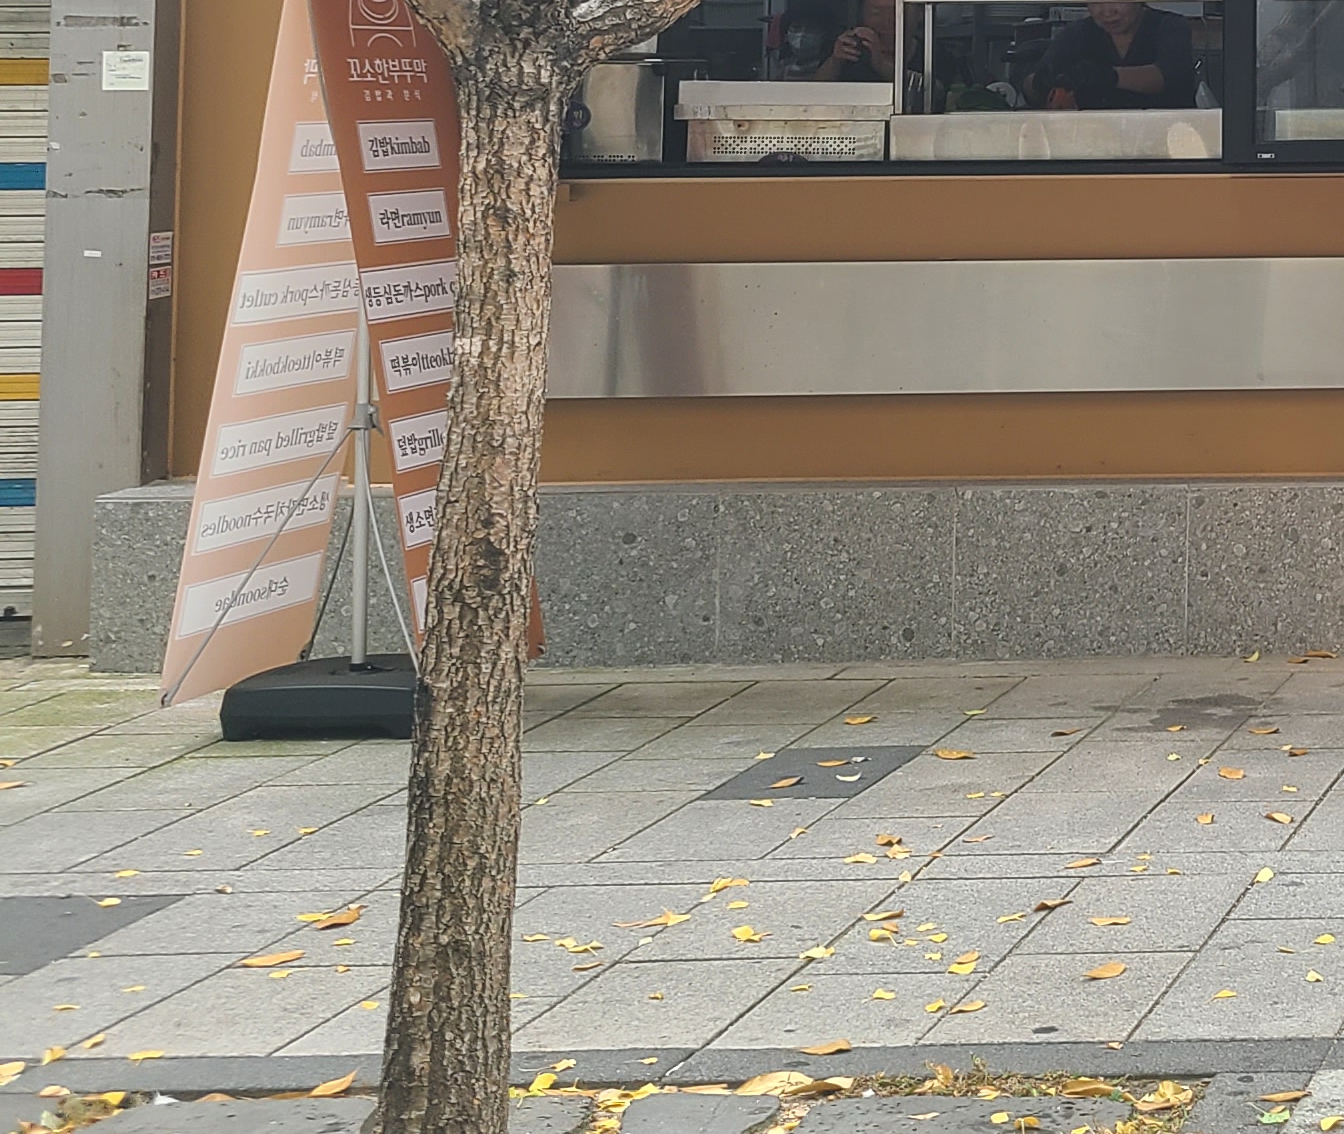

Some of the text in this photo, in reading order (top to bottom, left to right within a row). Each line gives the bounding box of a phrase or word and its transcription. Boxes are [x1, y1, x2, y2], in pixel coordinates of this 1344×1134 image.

[347, 58, 428, 84] 꼬소한부뚜막
[363, 89, 421, 101] 김밥과 분식
[368, 135, 431, 158] 김밥kimbab
[379, 208, 443, 230] 라면ramyun
